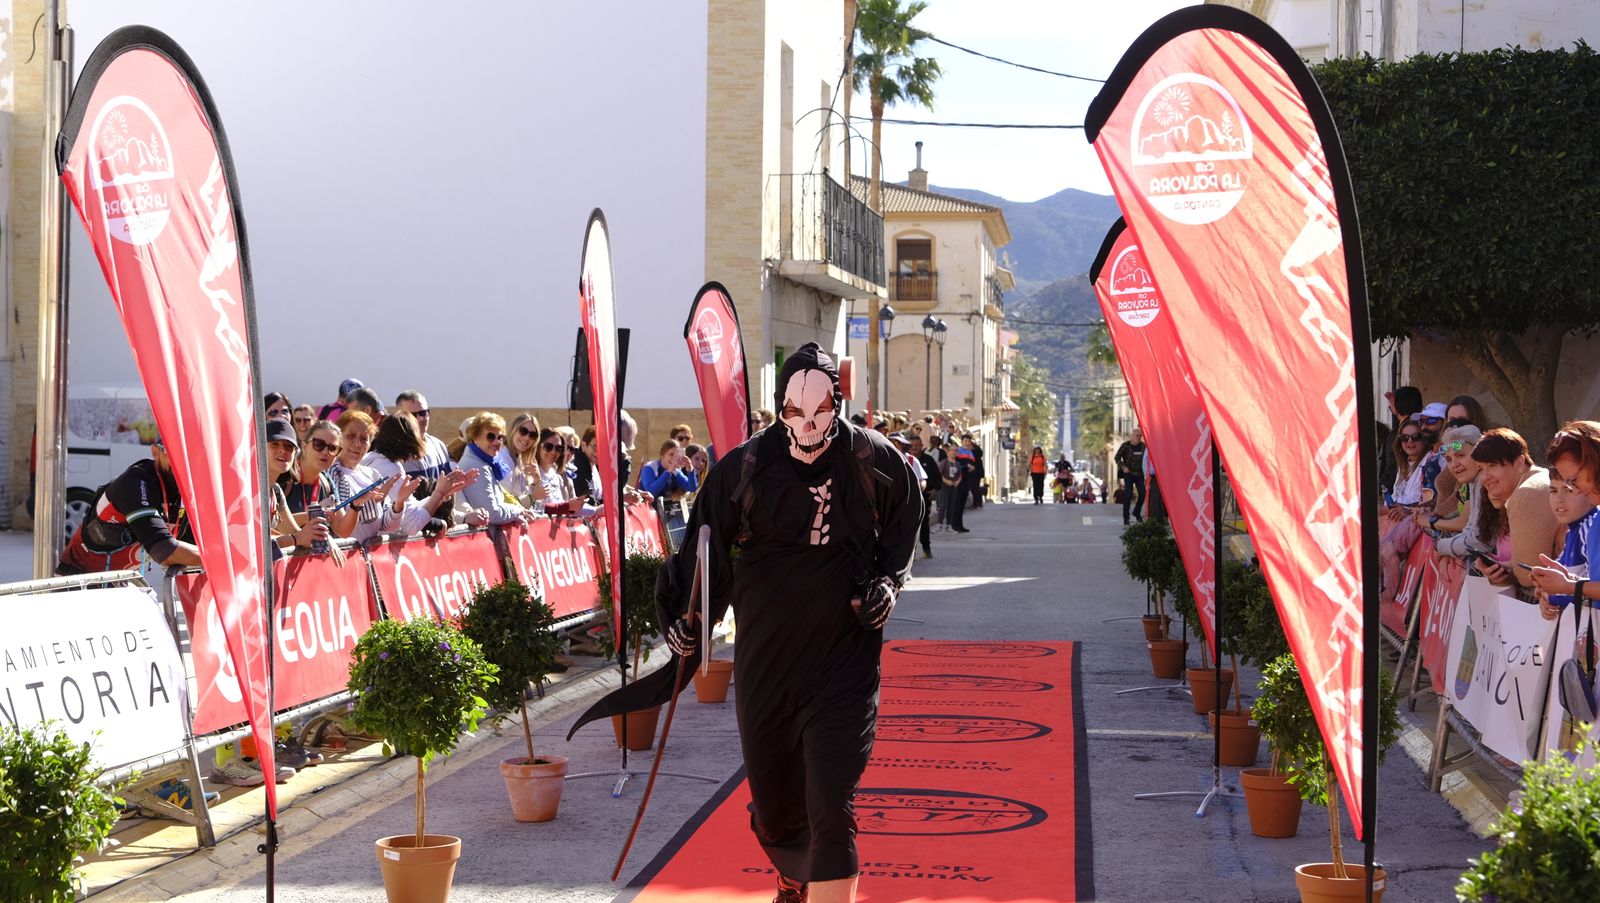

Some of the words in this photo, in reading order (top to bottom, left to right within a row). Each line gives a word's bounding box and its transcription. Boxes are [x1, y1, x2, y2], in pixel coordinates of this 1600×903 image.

[539, 546, 592, 589] VEOLIA
[124, 629, 153, 653] DE
[276, 595, 359, 663] EOLIA
